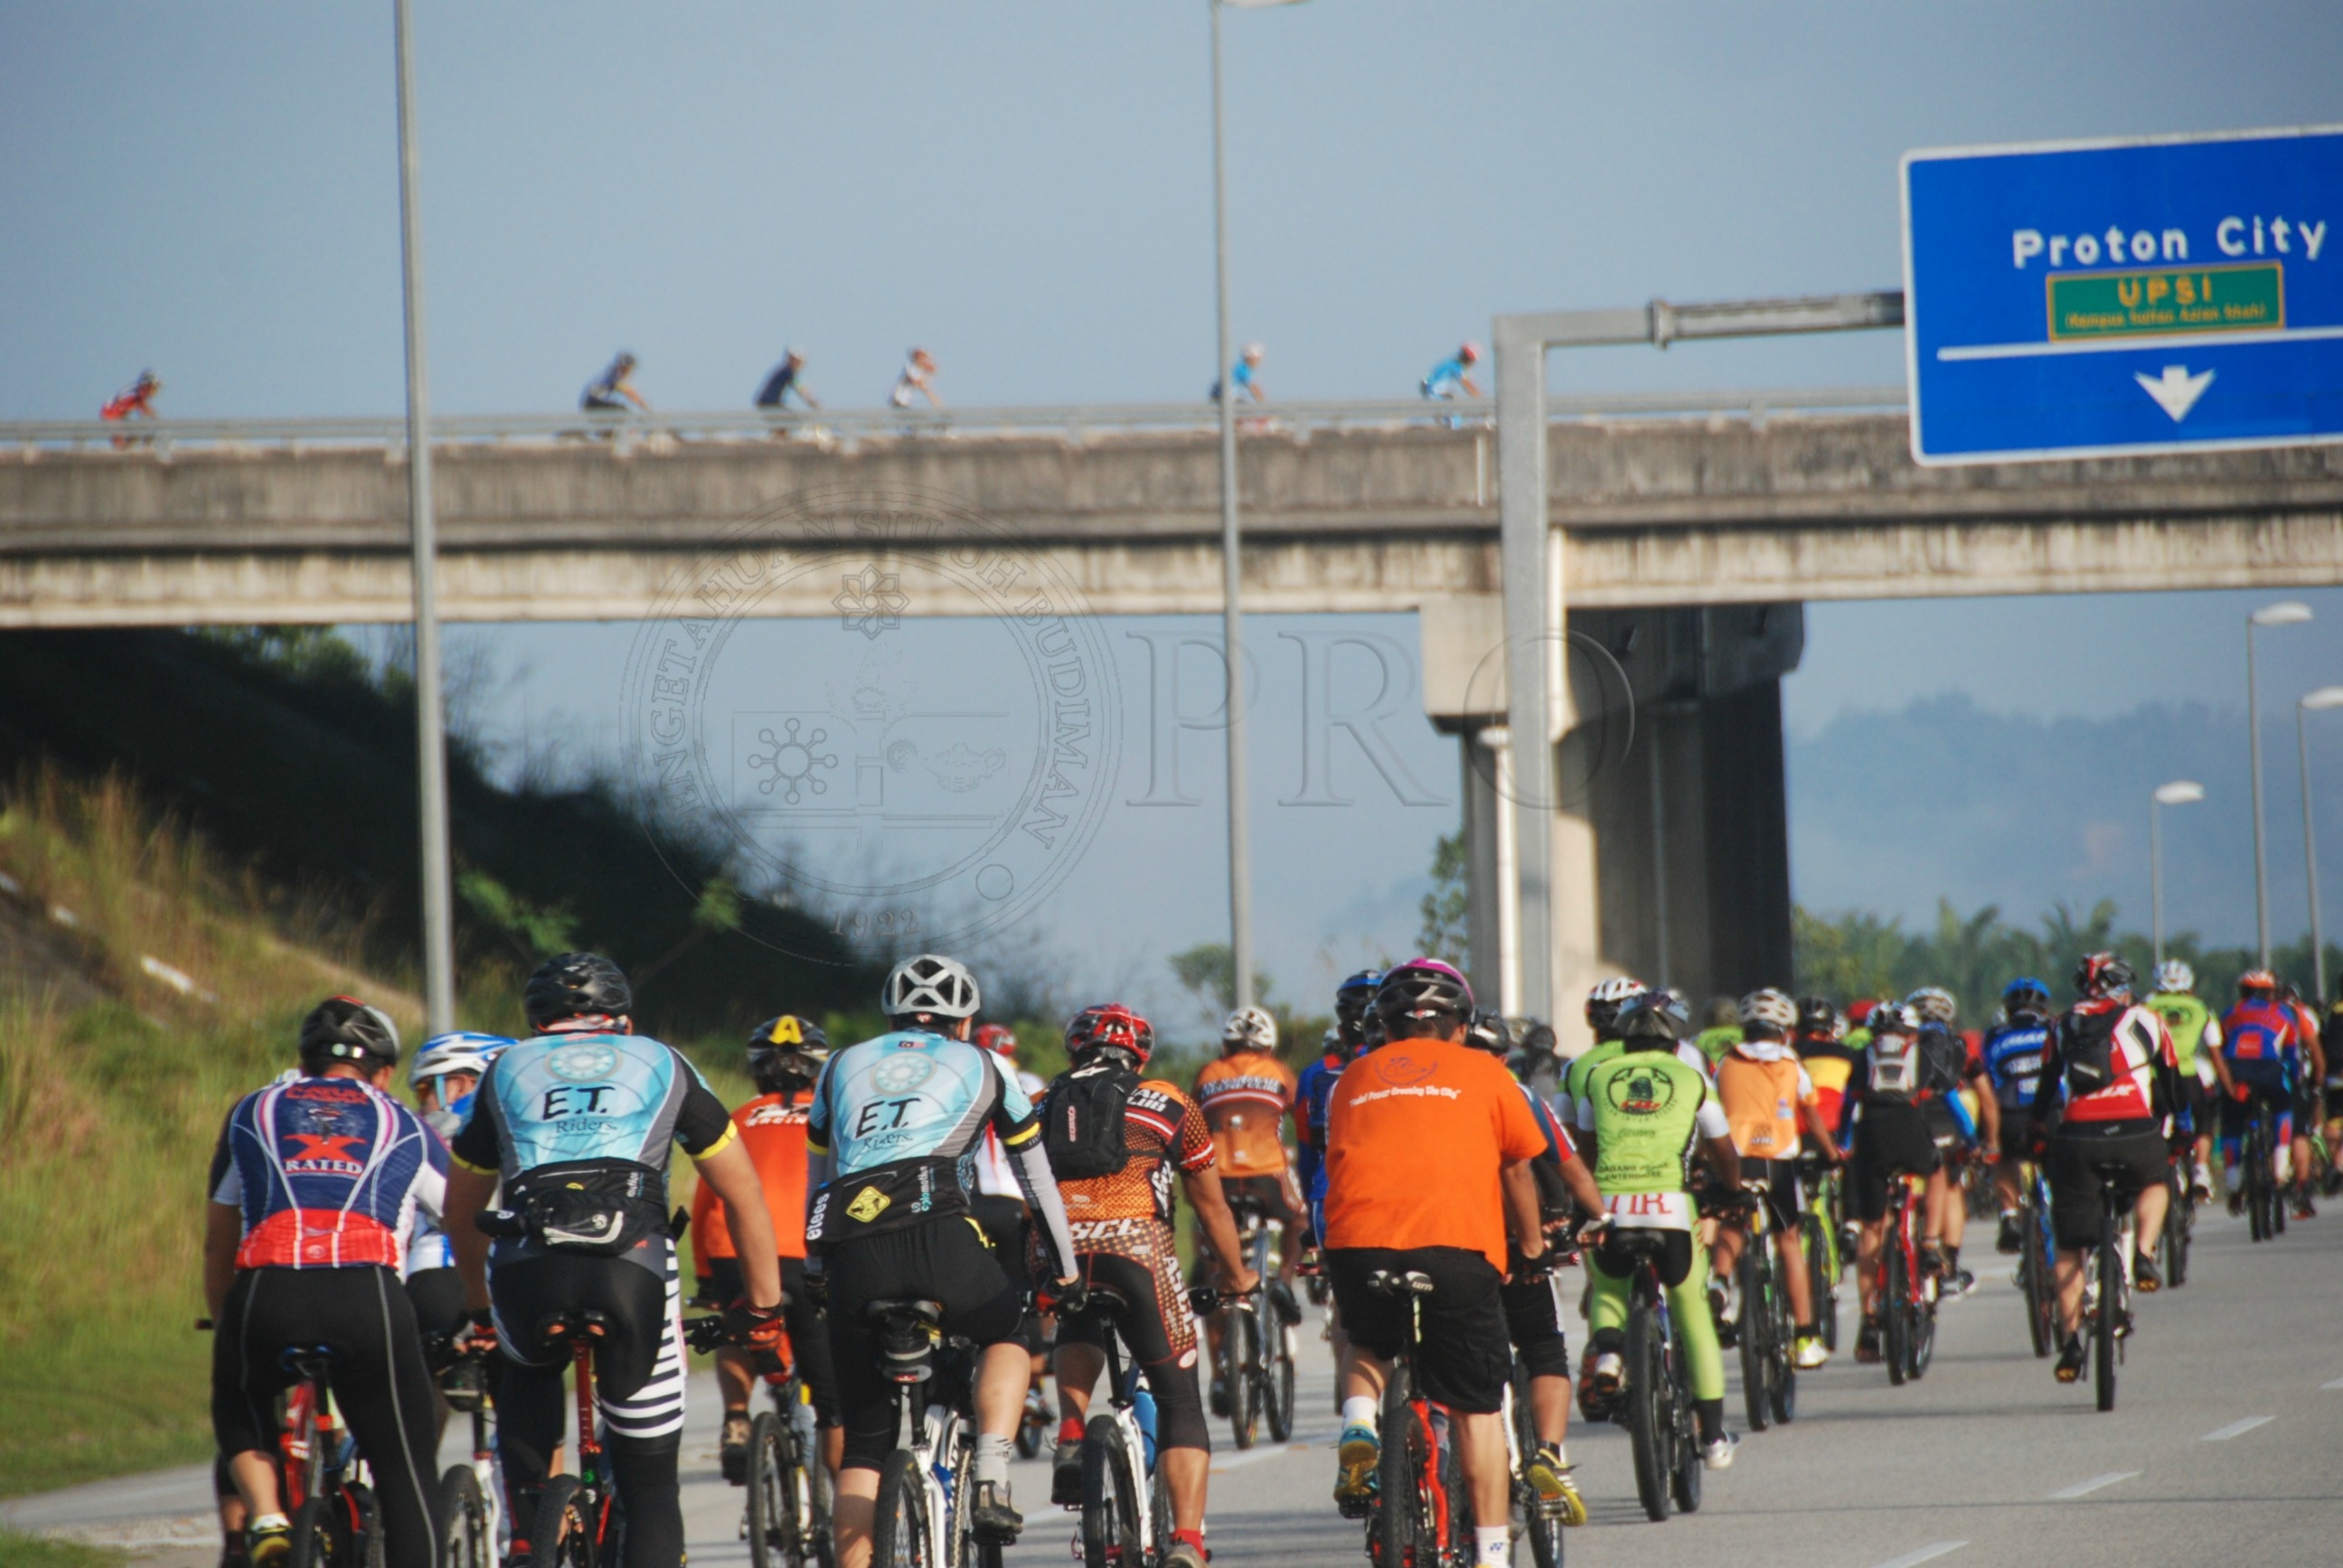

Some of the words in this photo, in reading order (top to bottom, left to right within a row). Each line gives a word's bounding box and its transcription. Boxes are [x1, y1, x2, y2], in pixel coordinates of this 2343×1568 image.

[2012, 225, 2189, 269] Proton
[2216, 214, 2328, 261] City
[2117, 274, 2212, 308] UPSI
[542, 1085, 616, 1121] E.T.
[855, 1097, 921, 1139] E.T.
[285, 1159, 363, 1175] RATED
